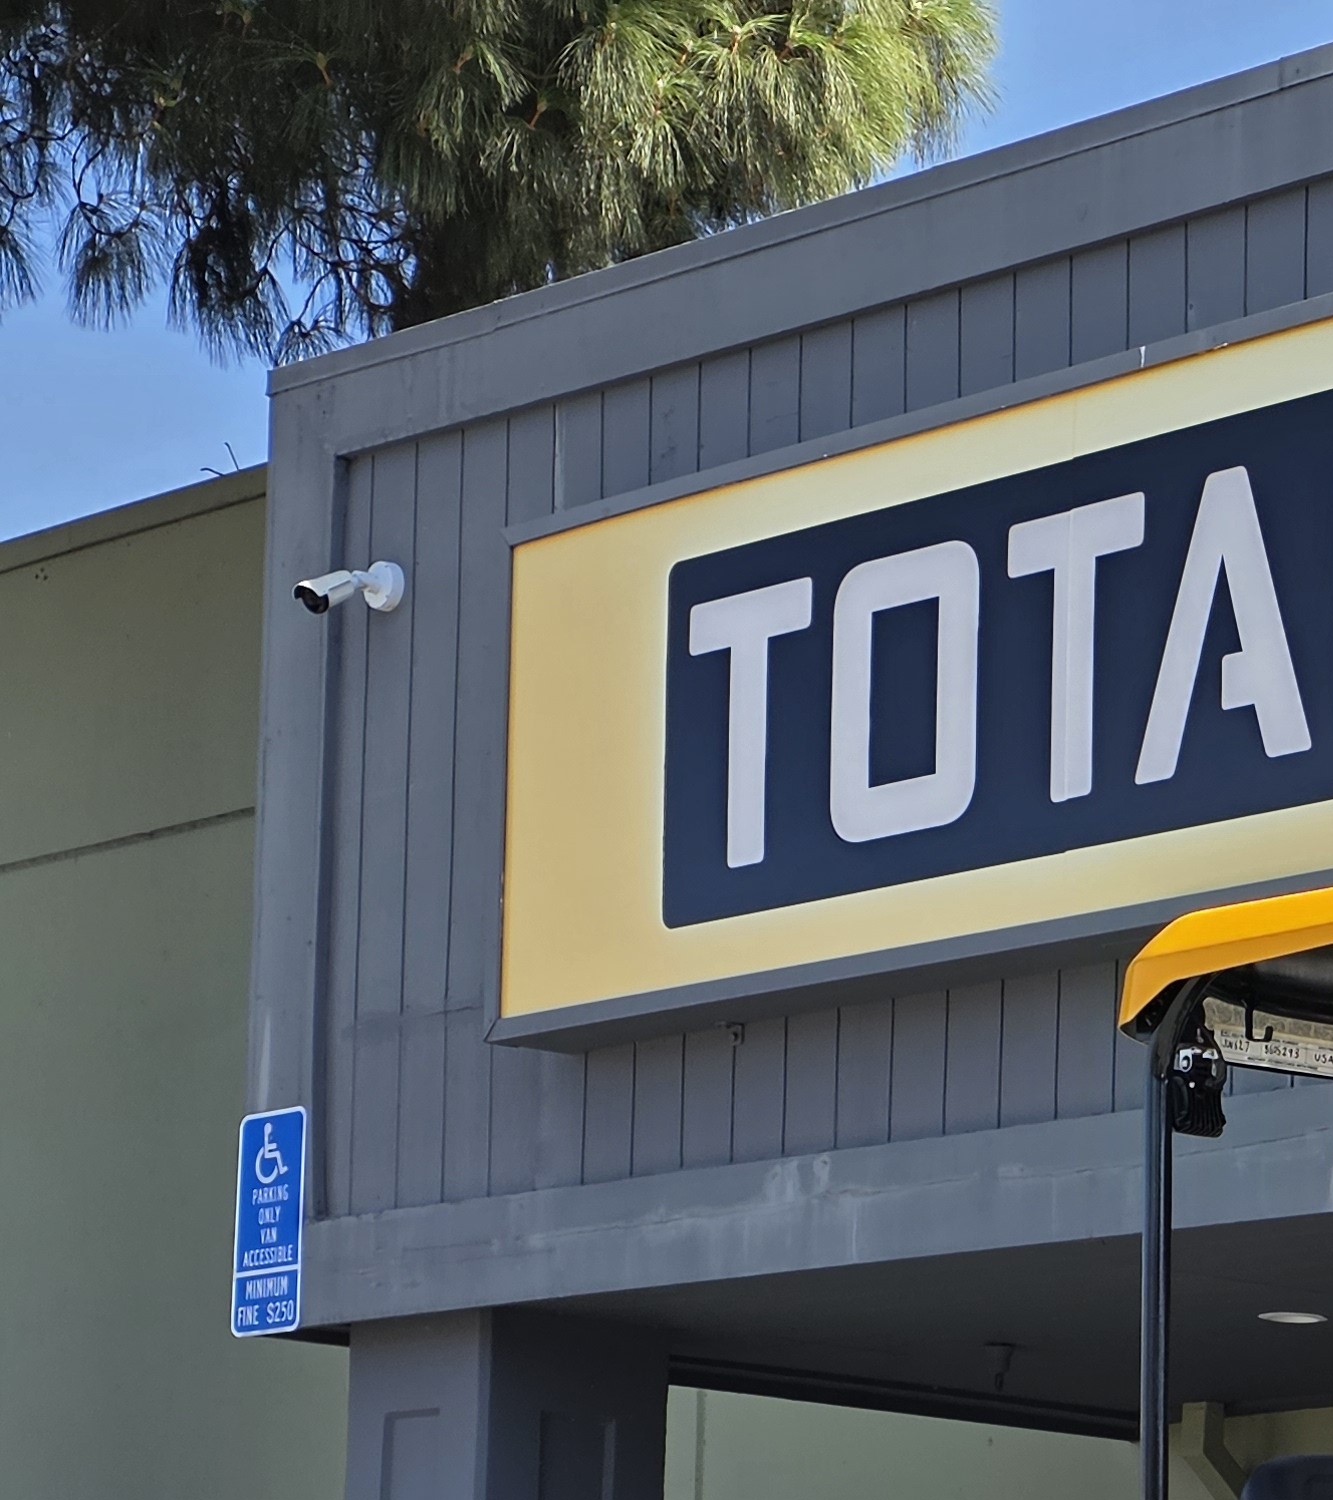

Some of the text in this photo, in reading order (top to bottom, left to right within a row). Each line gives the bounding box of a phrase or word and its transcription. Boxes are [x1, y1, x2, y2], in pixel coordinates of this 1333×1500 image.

[252, 1184, 288, 1205] PARKING
[258, 1206, 281, 1225] ONLY
[260, 1227, 277, 1245] VAN
[243, 1245, 293, 1267] ACCESSIBLE
[245, 1276, 288, 1300] MINIMUM
[237, 1300, 294, 1327] FINE $250
